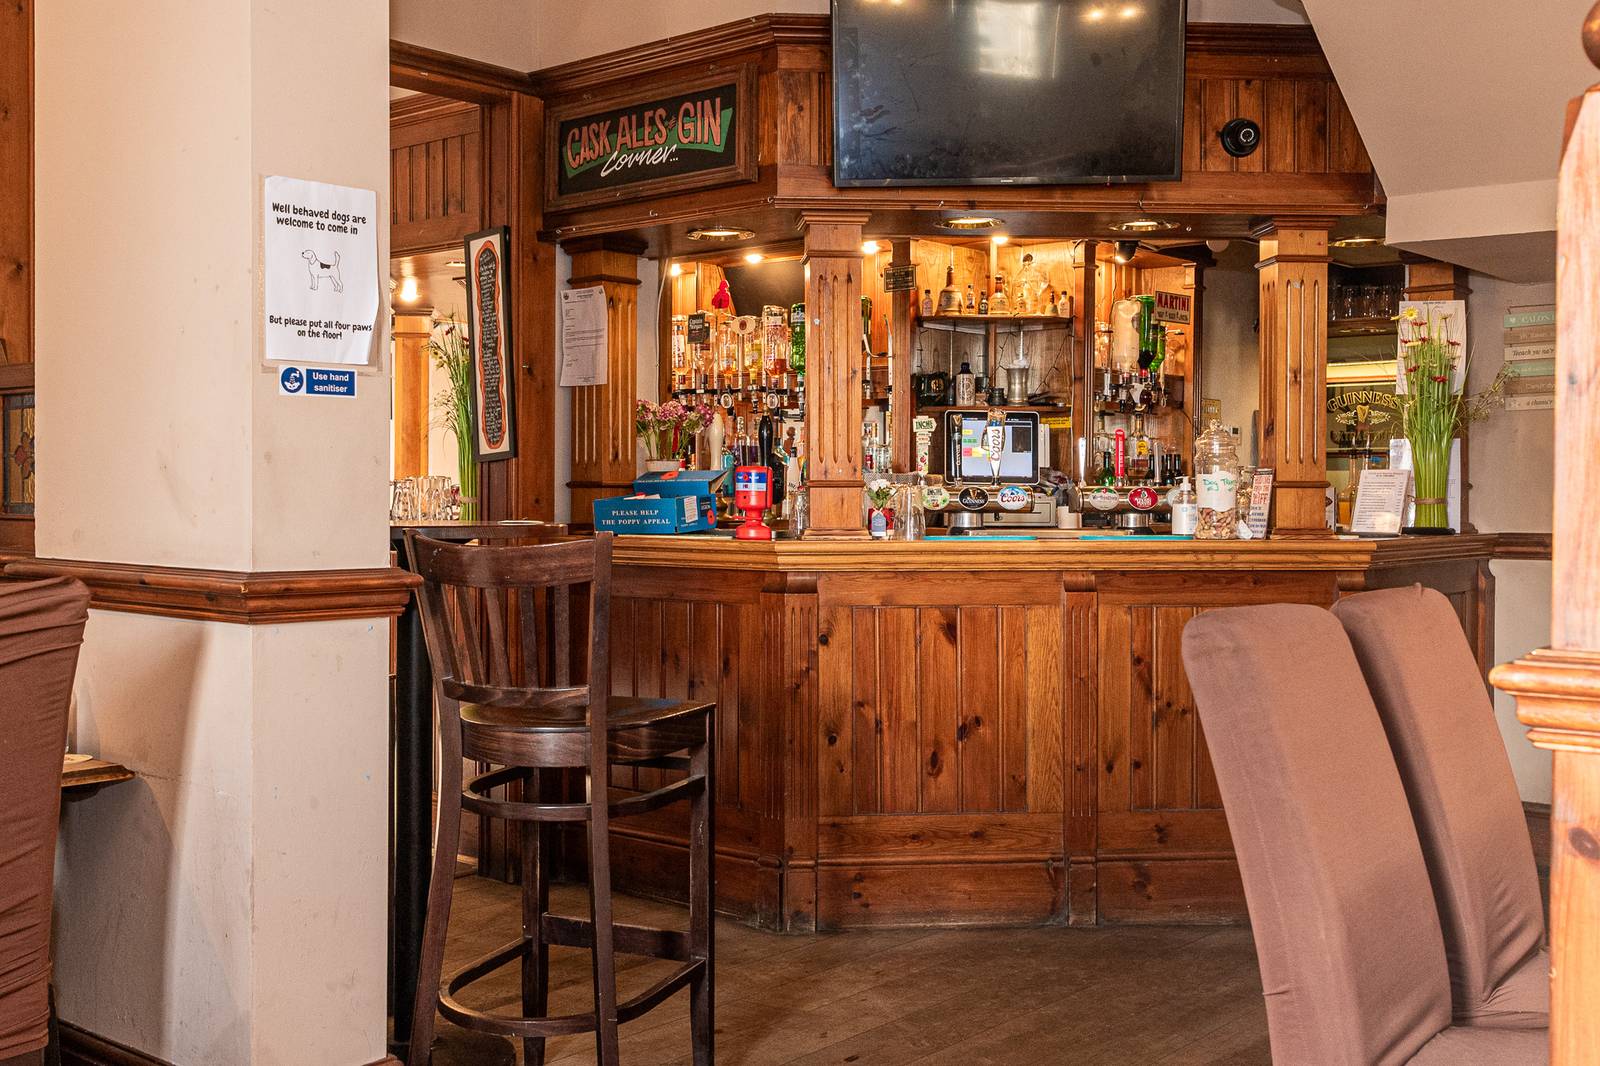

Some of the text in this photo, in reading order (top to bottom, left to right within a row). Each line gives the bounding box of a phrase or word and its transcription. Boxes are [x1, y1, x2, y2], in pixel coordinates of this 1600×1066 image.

[567, 120, 611, 169] CASK
[616, 108, 668, 151] ALES
[677, 97, 721, 146] GIN
[272, 202, 366, 225] Well behaved dogs are
[276, 217, 358, 235] welcome to come in
[1157, 292, 1190, 312] MARTINI
[269, 315, 372, 333] But please put all four paws
[297, 329, 342, 340] on the floor!
[312, 372, 349, 382] Use hand
[313, 384, 348, 393] sanitiser
[1327, 391, 1398, 412] GUINNESS
[990, 429, 1001, 461] Coors
[1000, 493, 1025, 503] Coors
